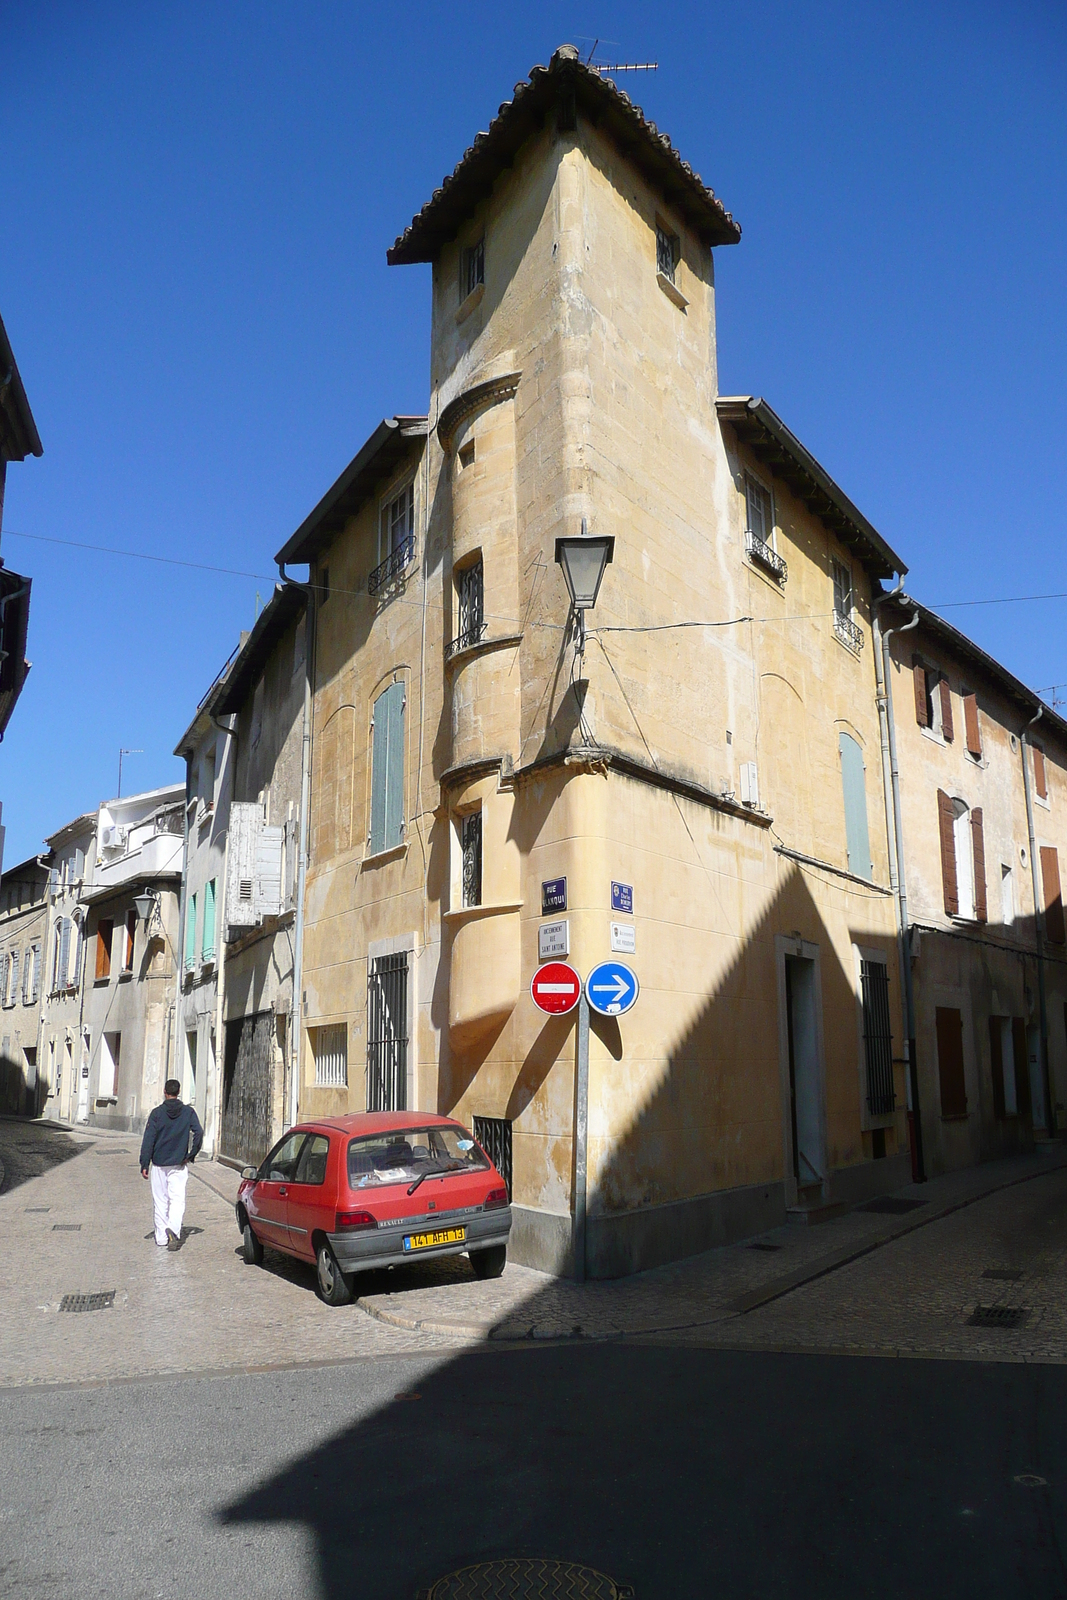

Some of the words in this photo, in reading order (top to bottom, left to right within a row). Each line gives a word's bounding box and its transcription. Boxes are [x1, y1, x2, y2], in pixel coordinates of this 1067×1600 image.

[546, 885, 557, 894] RUE
[543, 895, 565, 907] BLANQUI
[542, 945, 551, 953] SAINT
[552, 943, 565, 951] ANTOINE
[379, 1219, 404, 1227] RENAULT
[413, 1235, 428, 1246] 141
[432, 1232, 449, 1243] AFH
[453, 1228, 463, 1239] 13
